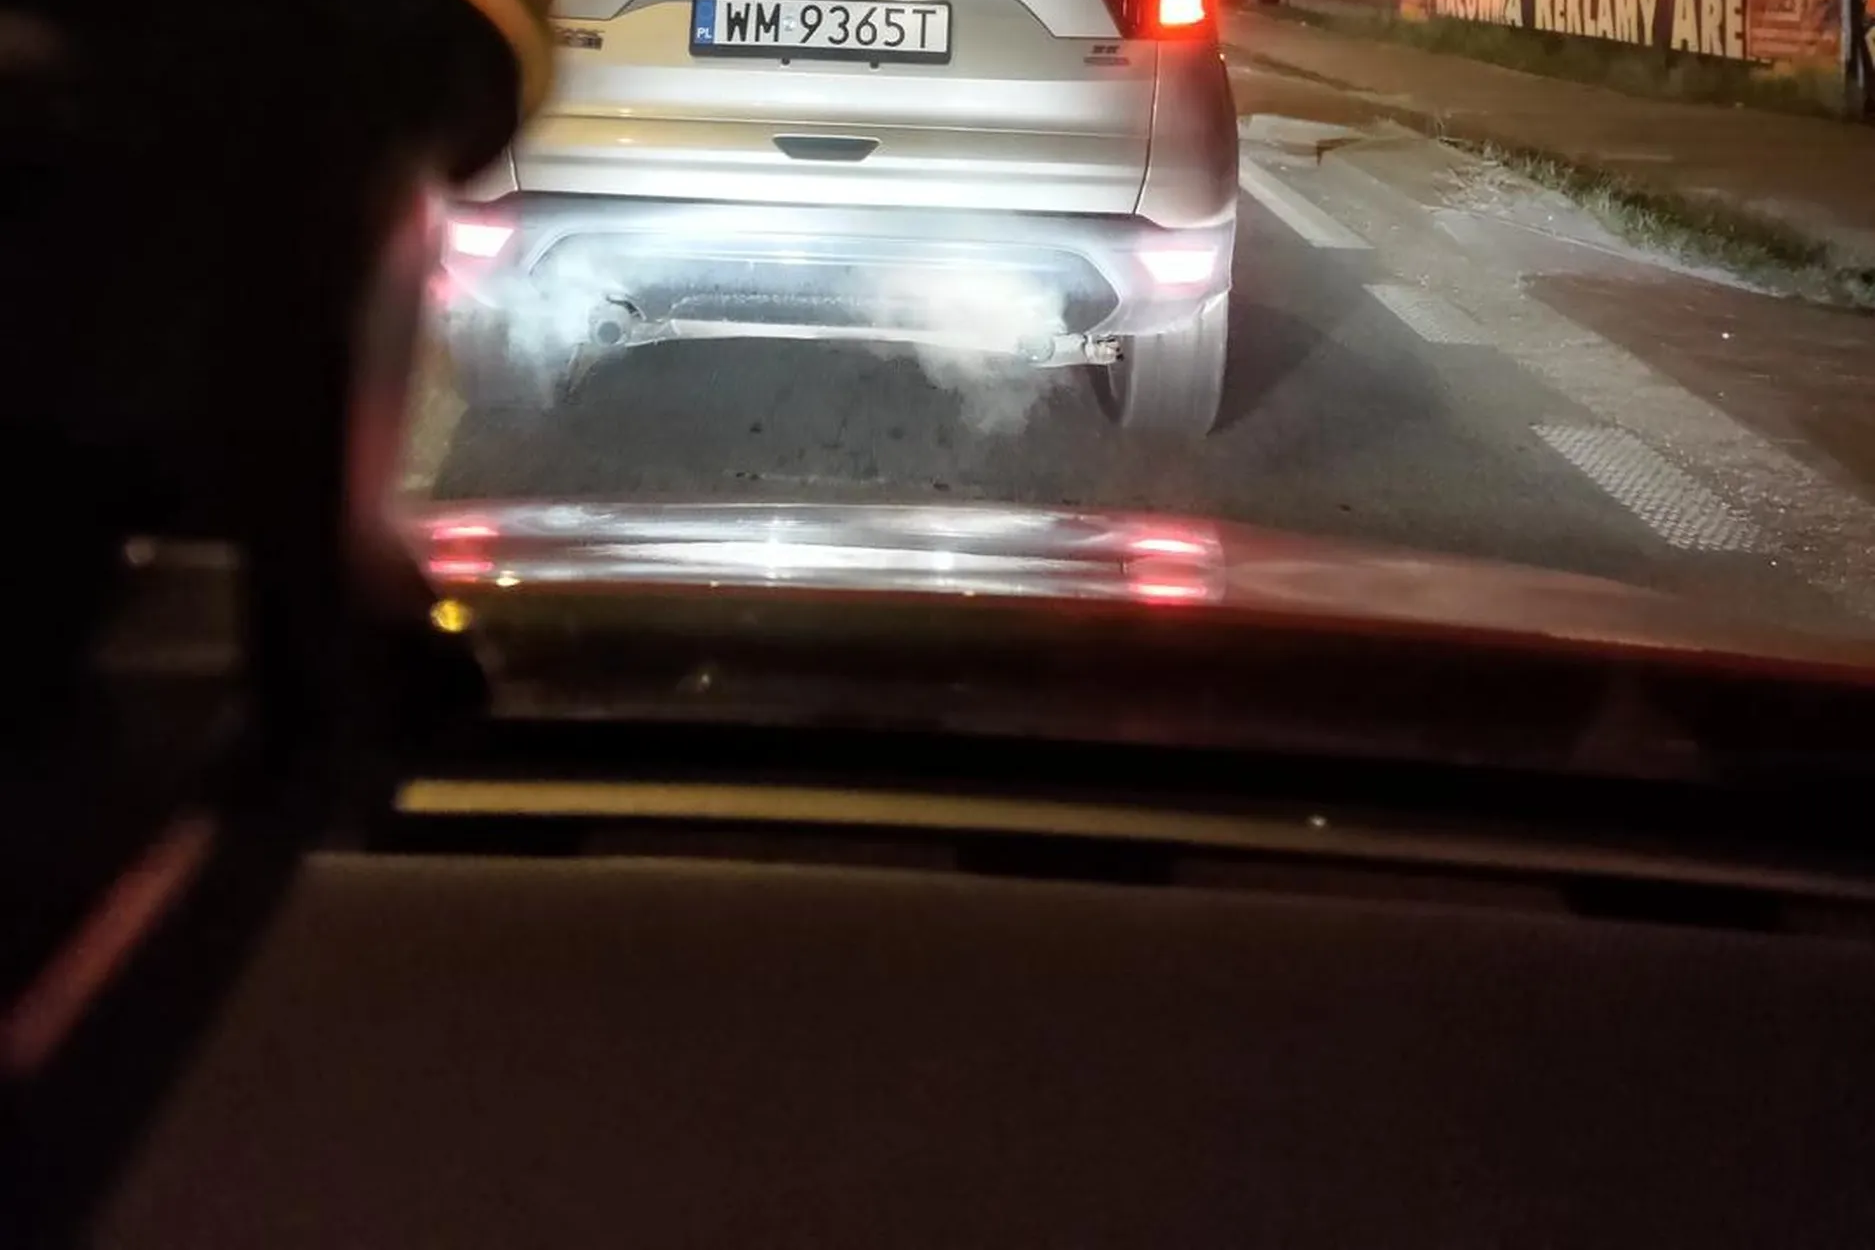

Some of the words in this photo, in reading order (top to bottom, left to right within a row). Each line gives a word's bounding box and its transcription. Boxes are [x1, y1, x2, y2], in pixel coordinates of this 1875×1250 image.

[697, 27, 712, 39] PL
[726, 1, 781, 42] WM
[799, 3, 937, 49] 9365T
